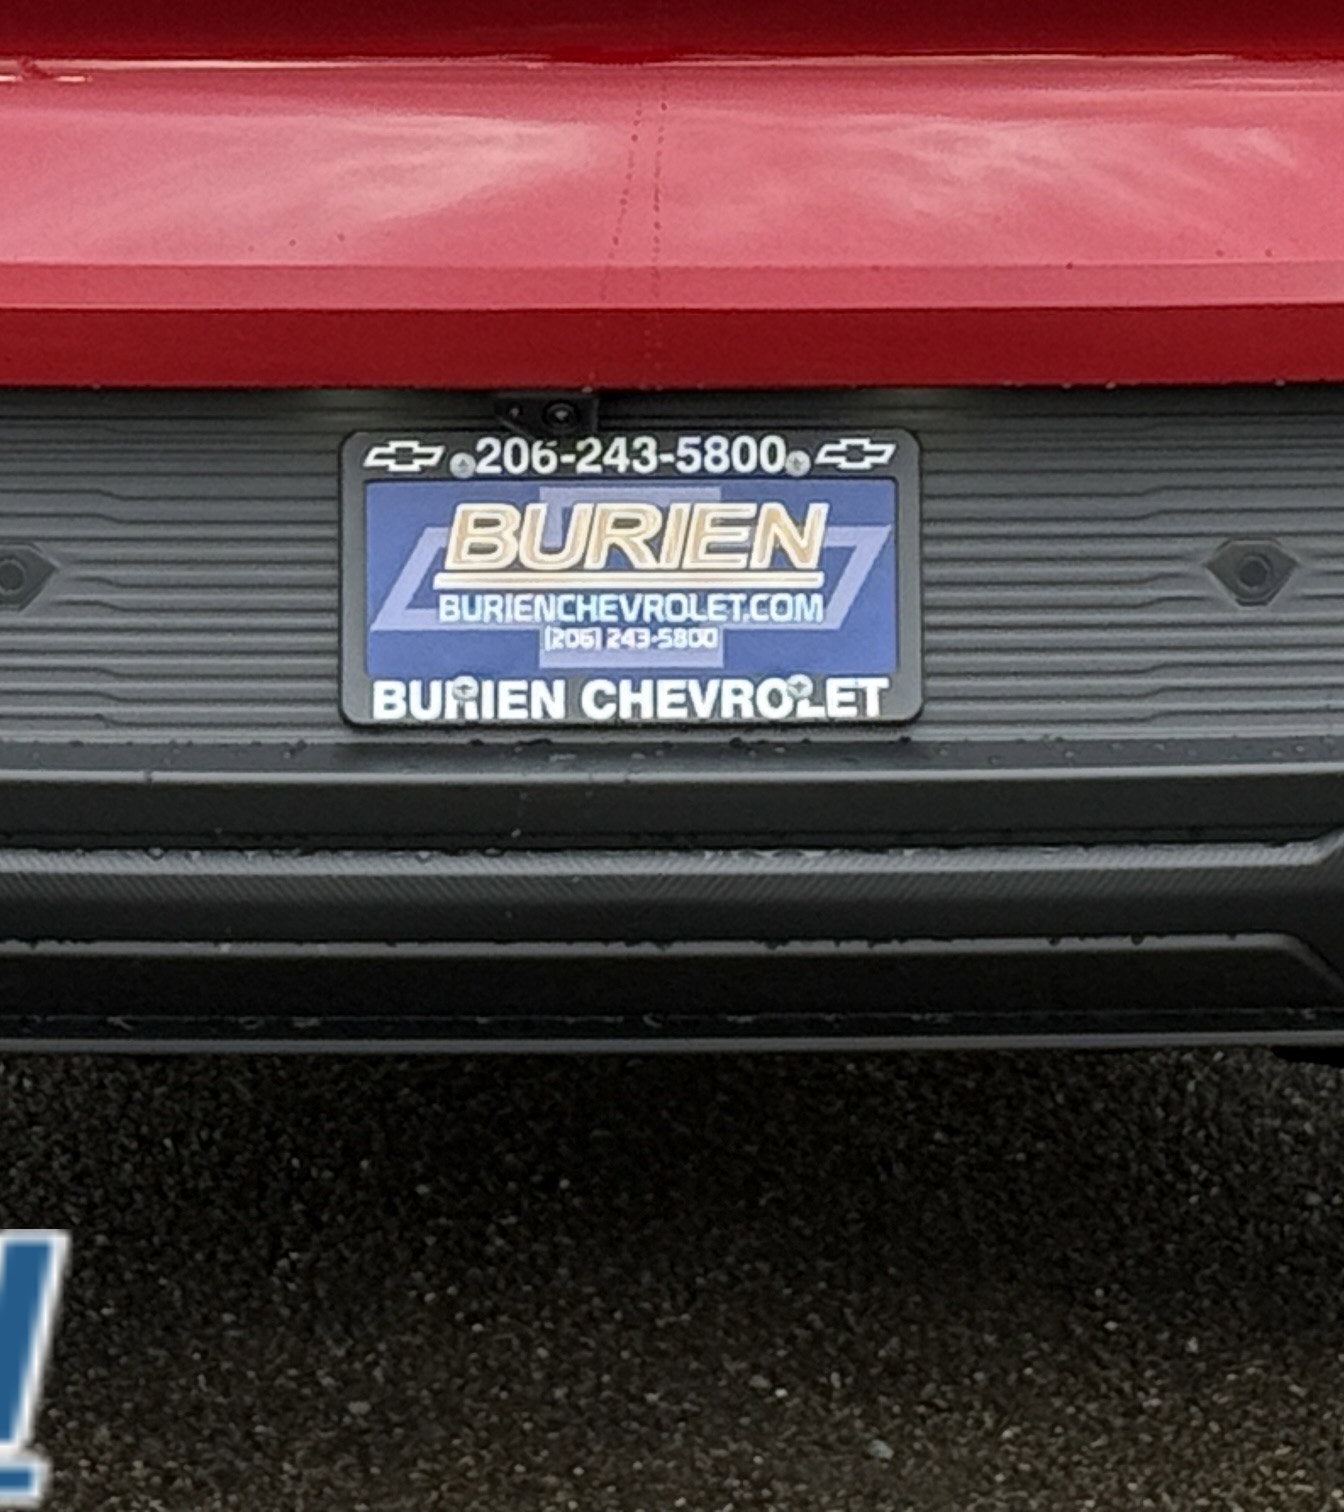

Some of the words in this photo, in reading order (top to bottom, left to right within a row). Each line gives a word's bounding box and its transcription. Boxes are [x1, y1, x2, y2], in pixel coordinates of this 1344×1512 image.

[474, 436, 787, 475] 206-243-5800
[443, 502, 830, 571] BURIEN
[438, 592, 825, 624] BURIENCHEVROLET.COM
[606, 627, 719, 649] 243-5800
[372, 678, 566, 720] BURIEN
[580, 677, 889, 720] CHEVROLET
